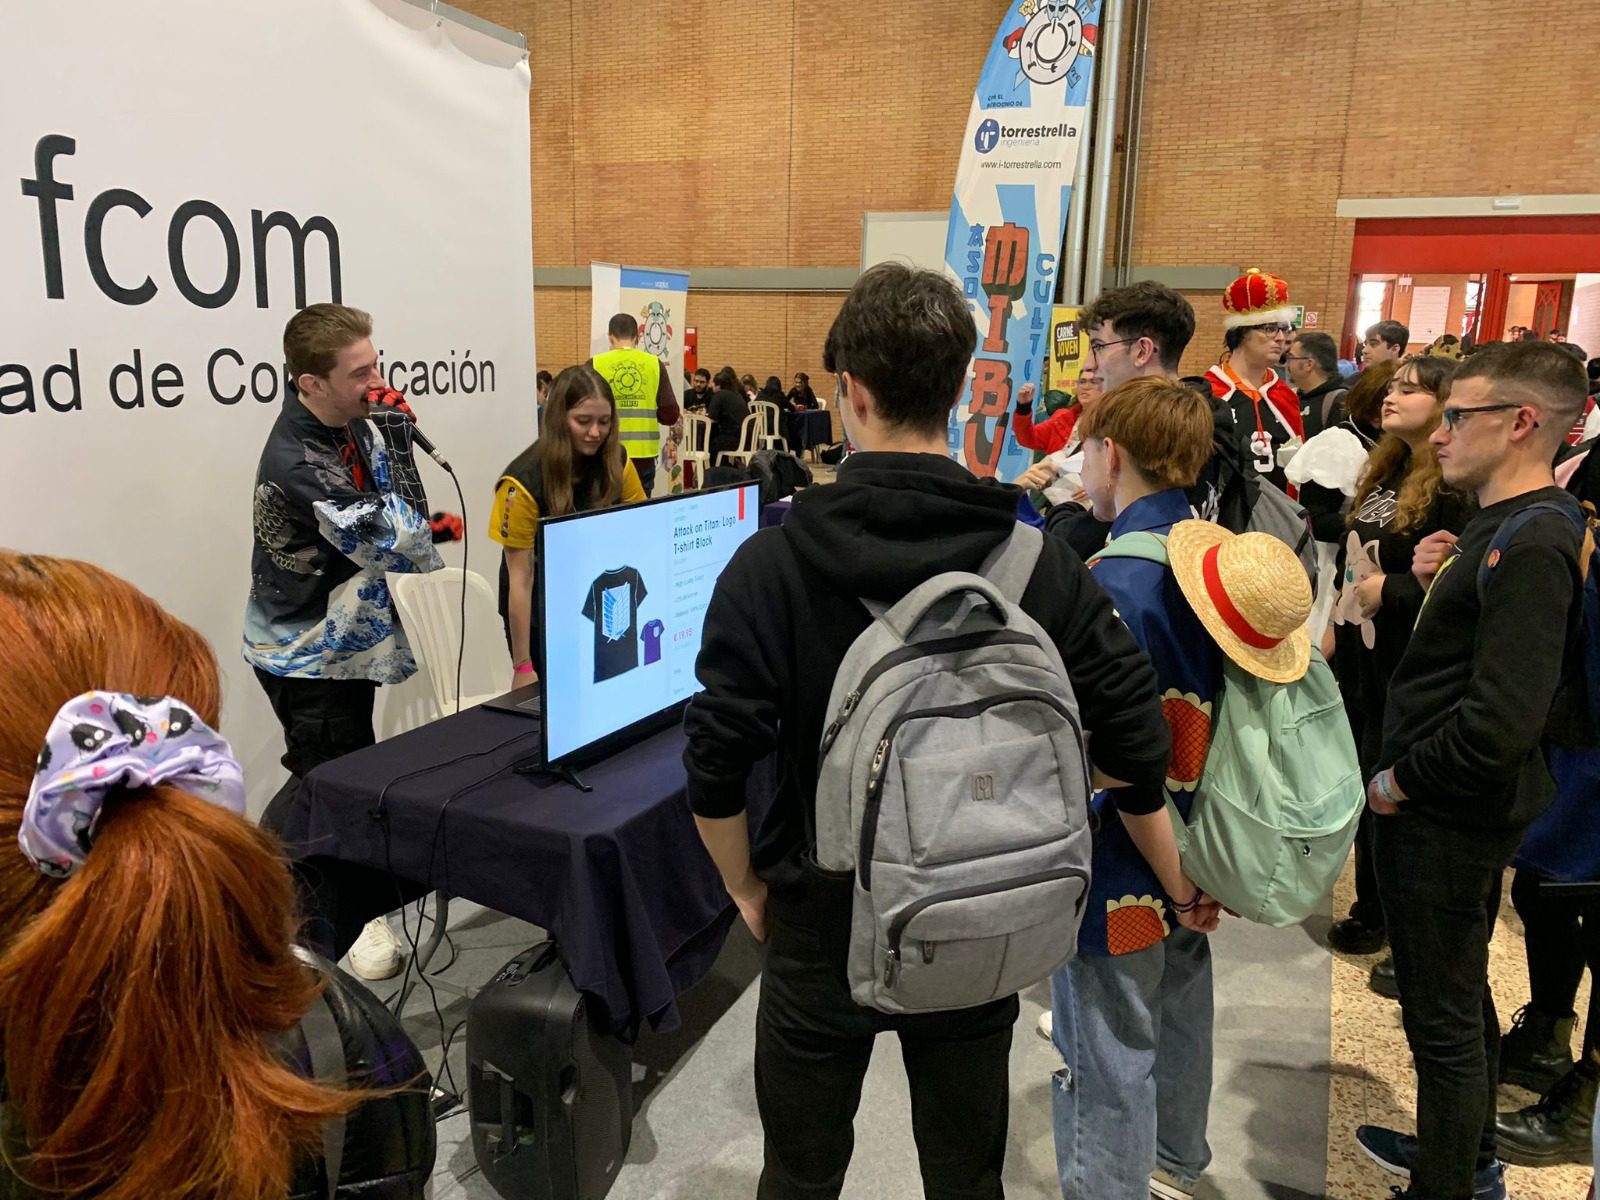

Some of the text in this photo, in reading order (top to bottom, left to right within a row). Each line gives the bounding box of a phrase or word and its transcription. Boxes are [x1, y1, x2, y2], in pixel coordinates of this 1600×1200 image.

[1001, 123, 1077, 138] torrestrella
[981, 160, 1062, 169] www.i-torrestrella.com
[20, 133, 343, 309] fcom
[1057, 323, 1074, 338] CARNÉ
[1007, 253, 1055, 456] CULTUL
[1057, 340, 1079, 357] JOVEN
[108, 348, 185, 409] de
[206, 347, 496, 406] Coicación
[673, 523, 694, 539] Attack
[695, 523, 703, 534] on
[722, 515, 737, 528] Logo
[673, 535, 713, 555] T-shirt Black
